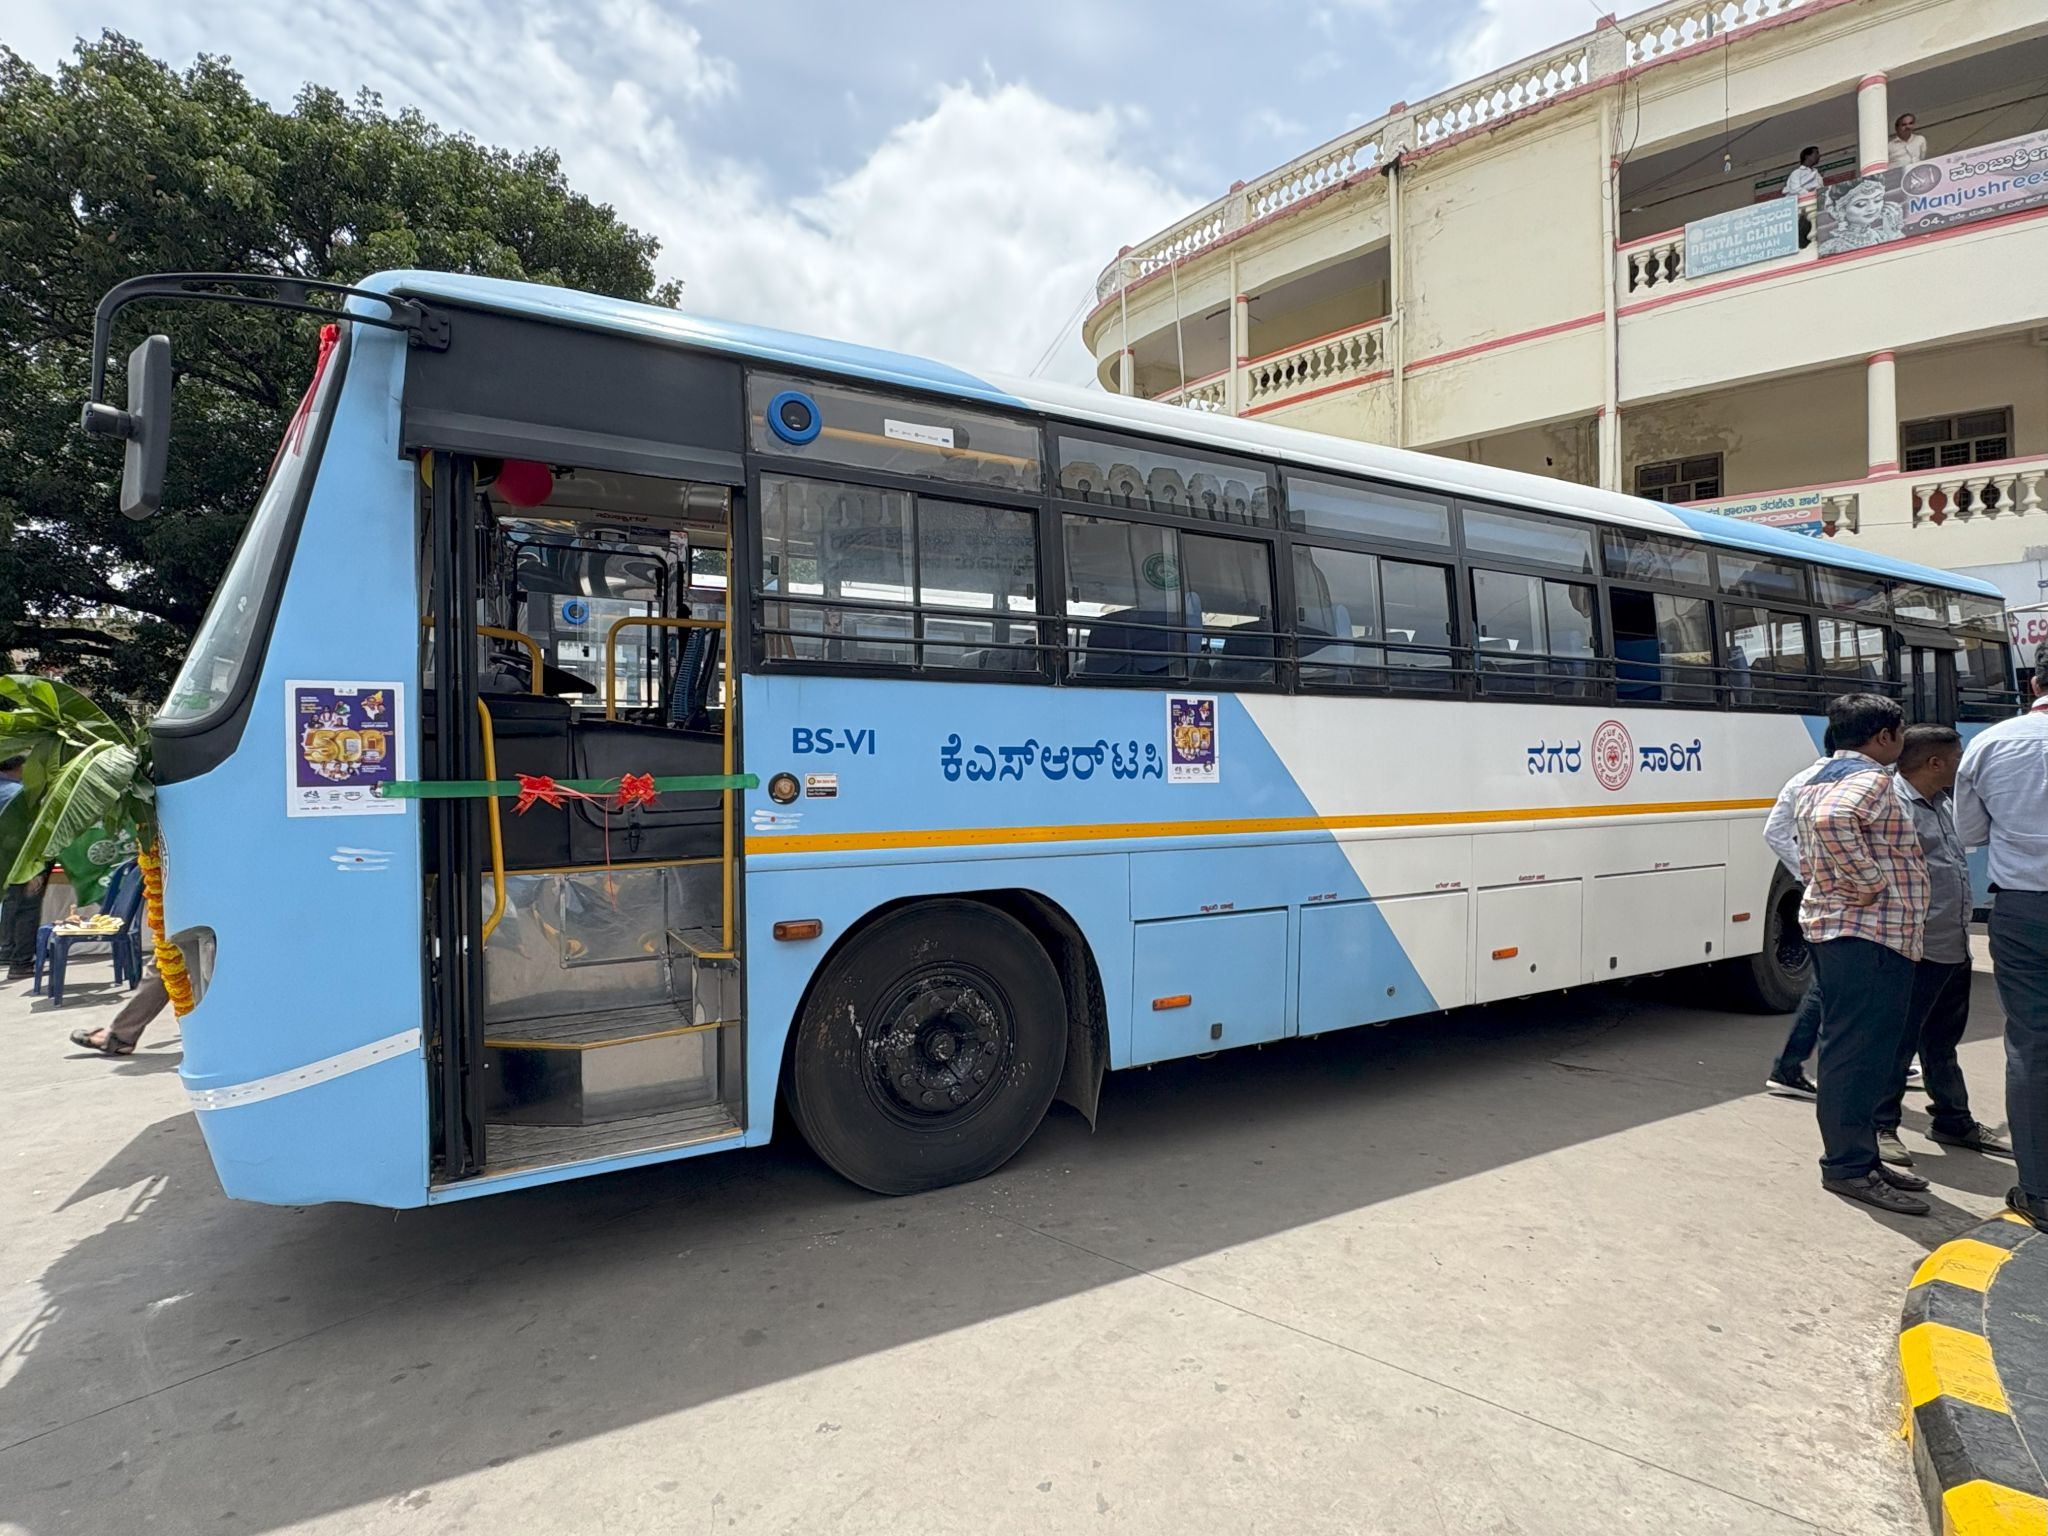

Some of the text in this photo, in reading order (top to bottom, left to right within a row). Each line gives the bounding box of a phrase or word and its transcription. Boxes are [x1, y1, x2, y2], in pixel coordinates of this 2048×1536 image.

[1691, 220, 1793, 256] DENTAL CLINIC
[792, 727, 876, 755] BS-VI
[1527, 739, 1582, 775] ನಗರ
[1639, 738, 1702, 772] ಸಾರಿಗೆ
